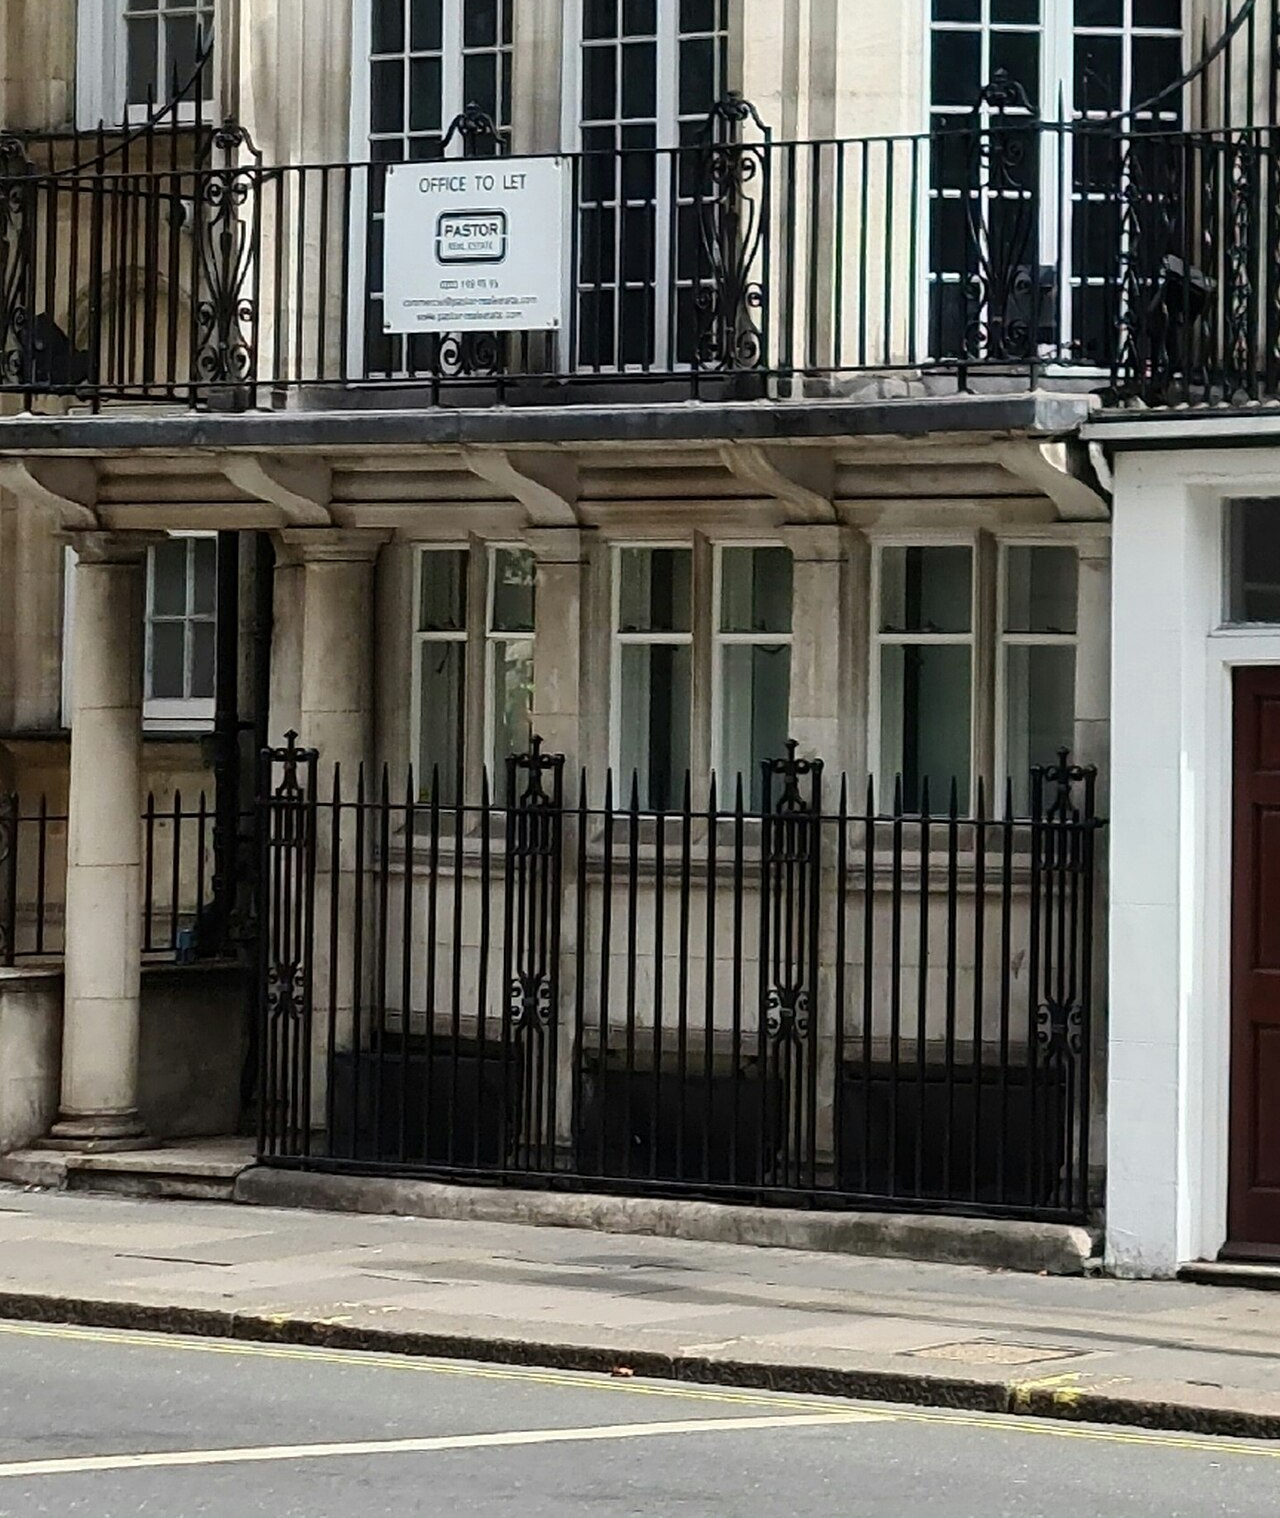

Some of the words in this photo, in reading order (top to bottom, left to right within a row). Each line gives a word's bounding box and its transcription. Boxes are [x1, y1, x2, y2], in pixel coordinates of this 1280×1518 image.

[419, 176, 466, 193] OFFICE
[475, 175, 494, 191] TO
[503, 174, 526, 190] LET
[445, 223, 498, 238] PASTOR
